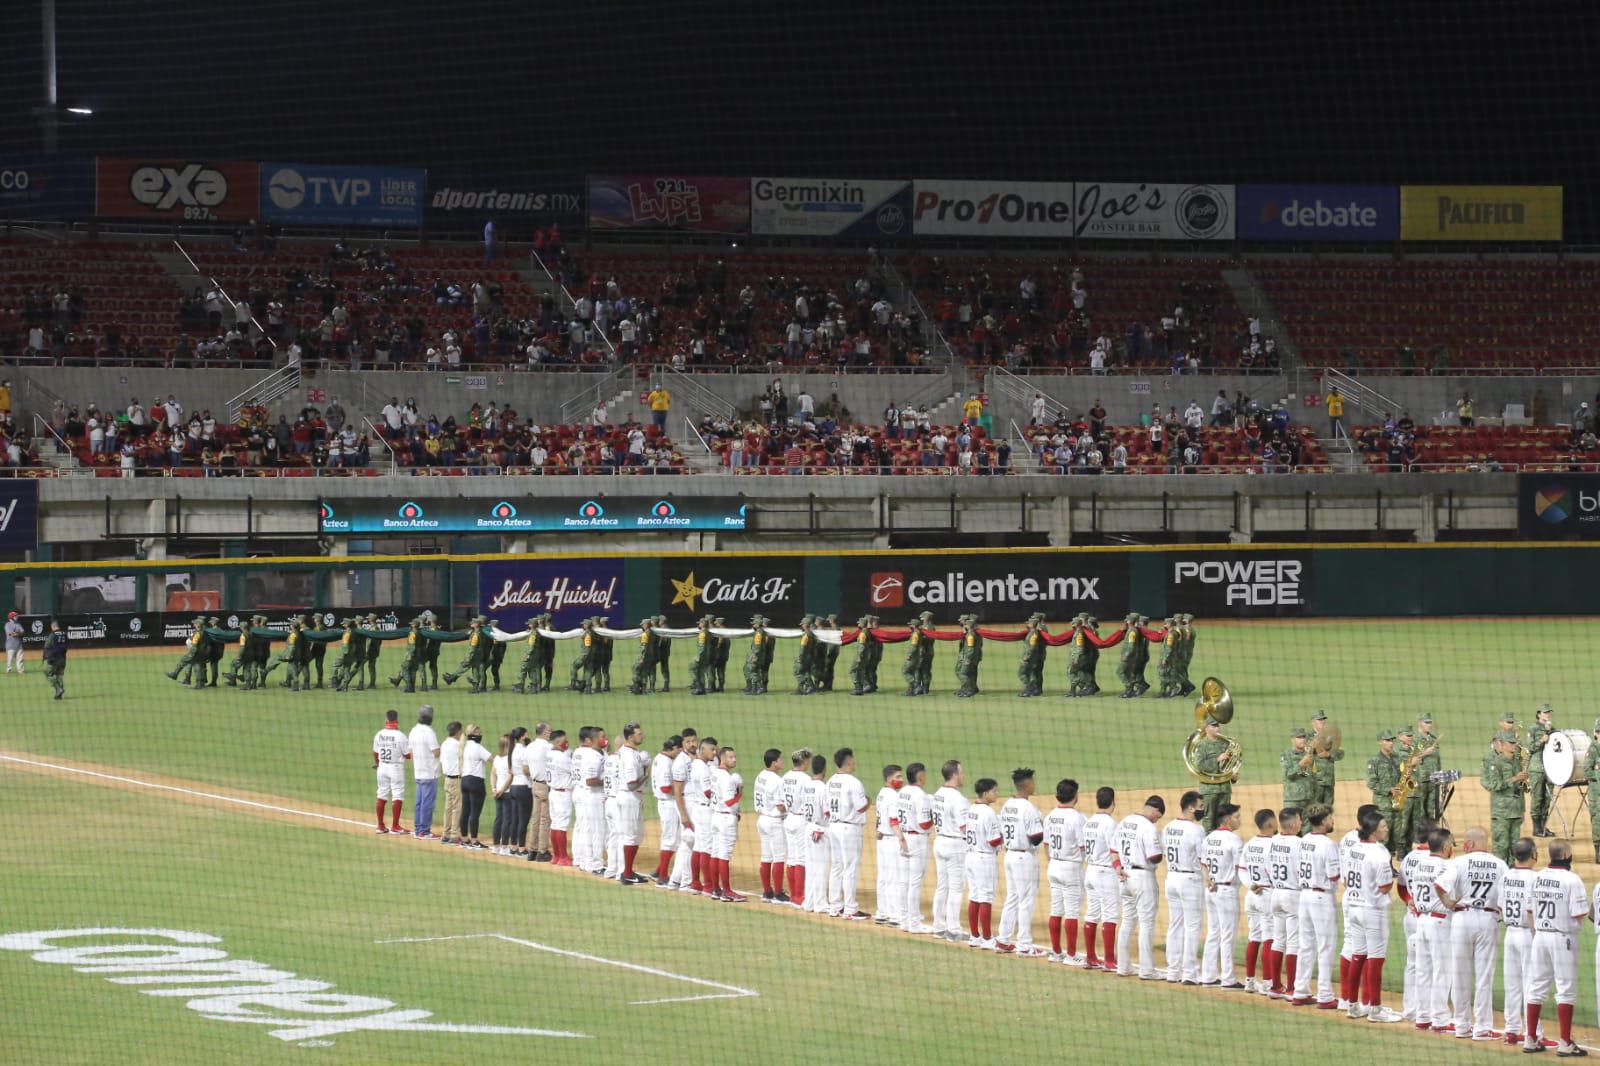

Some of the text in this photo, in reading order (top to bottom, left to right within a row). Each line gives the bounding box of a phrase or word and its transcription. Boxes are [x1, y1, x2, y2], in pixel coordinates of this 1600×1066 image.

[131, 164, 227, 208] exa
[307, 177, 370, 205] TVP
[756, 180, 863, 202] Germixin
[381, 196, 416, 205] LOCAL
[1076, 184, 1165, 236] Joe's
[1281, 199, 1377, 227] debate
[1091, 223, 1161, 233] OYSTER BAR
[384, 519, 439, 527] Banco Azteca
[477, 518, 532, 527] Banco Azteca
[564, 517, 618, 526] Banco Azteca
[637, 517, 691, 525] Banco Azteca
[1176, 560, 1301, 584] POWER
[489, 577, 616, 609] Salsa Huichol
[702, 577, 790, 604] Carl's Jr.
[909, 572, 1099, 603] caliente.mx
[1167, 846, 1179, 864] 61
[1469, 858, 1497, 869] PACIFICO
[1272, 863, 1288, 881] 33
[1347, 870, 1361, 889] 89
[1468, 871, 1497, 880] ROJAS
[1417, 884, 1431, 903] 72
[1470, 881, 1493, 899] 77
[1505, 900, 1520, 918] 63
[1537, 900, 1555, 919] 70
